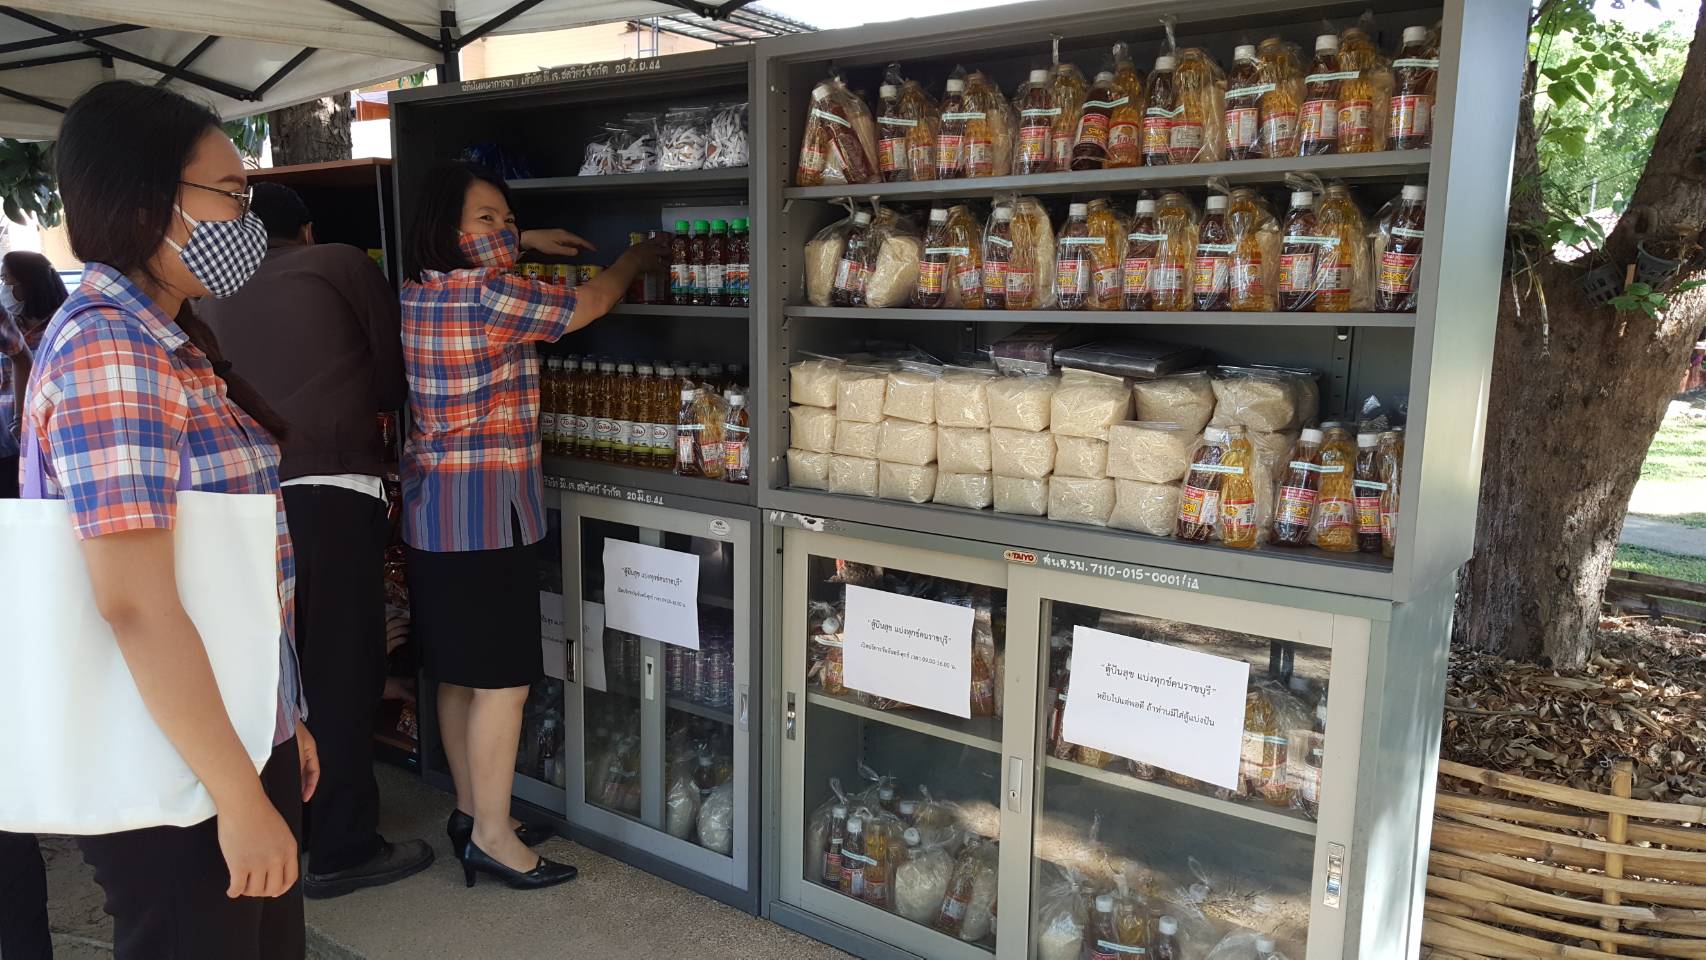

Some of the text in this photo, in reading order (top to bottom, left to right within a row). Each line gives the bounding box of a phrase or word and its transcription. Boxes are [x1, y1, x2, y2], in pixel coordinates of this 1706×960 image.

[615, 63, 626, 74] 20
[626, 490, 637, 501] 20
[1013, 551, 1035, 562] TAIYO
[1097, 691, 1145, 711] หยิบไปแต่พอดี
